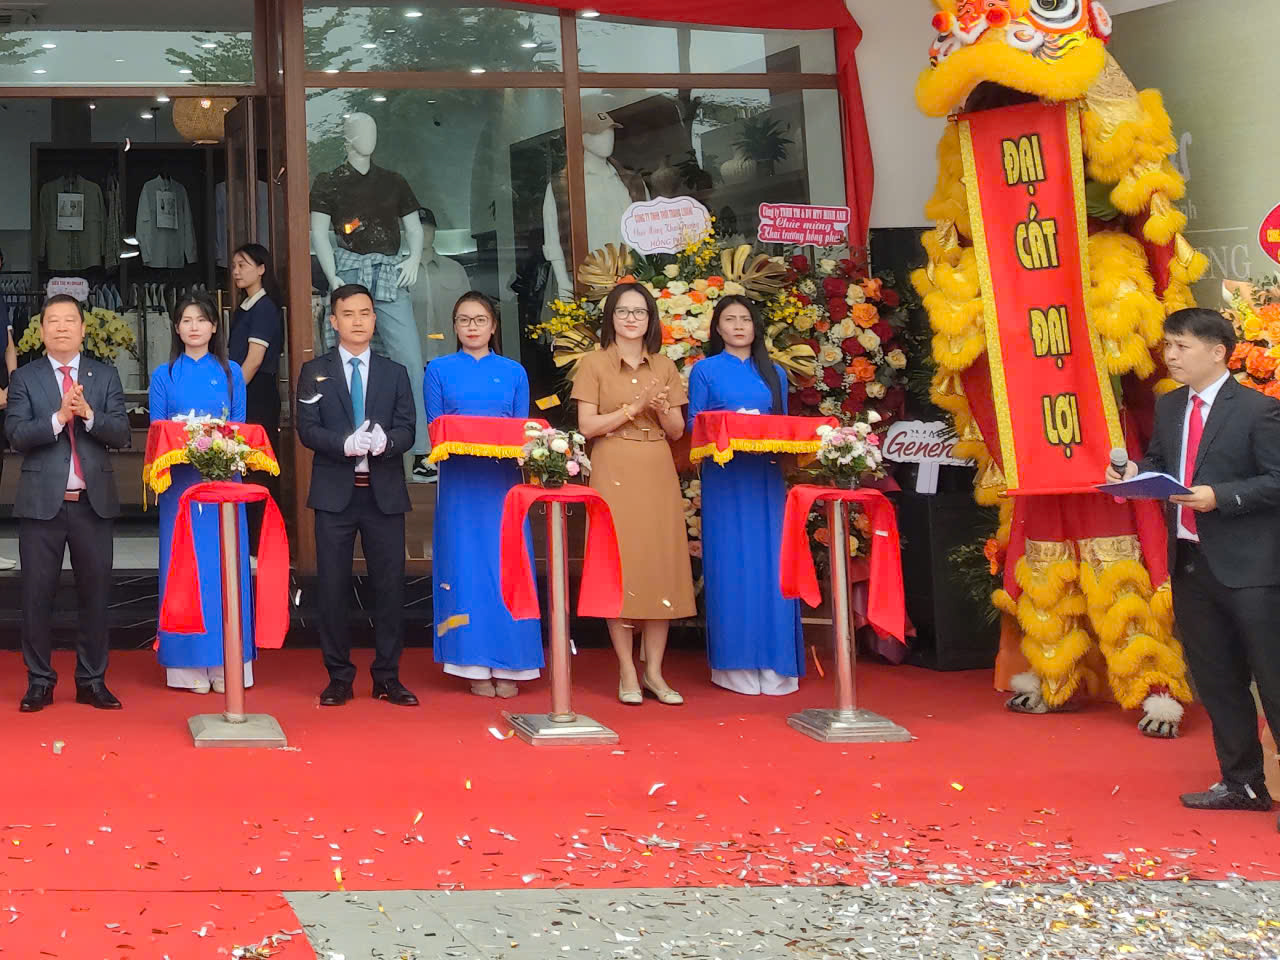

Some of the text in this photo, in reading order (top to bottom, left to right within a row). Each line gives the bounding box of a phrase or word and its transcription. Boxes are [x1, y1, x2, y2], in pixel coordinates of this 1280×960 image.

[1002, 133, 1046, 196] ĐẠI
[762, 226, 780, 238] Khai
[775, 218, 800, 228] Chúc
[1015, 201, 1060, 270] CÁT
[1029, 305, 1072, 370] ĐẠI
[886, 431, 953, 459] Gener
[1042, 392, 1082, 459] LỢI
